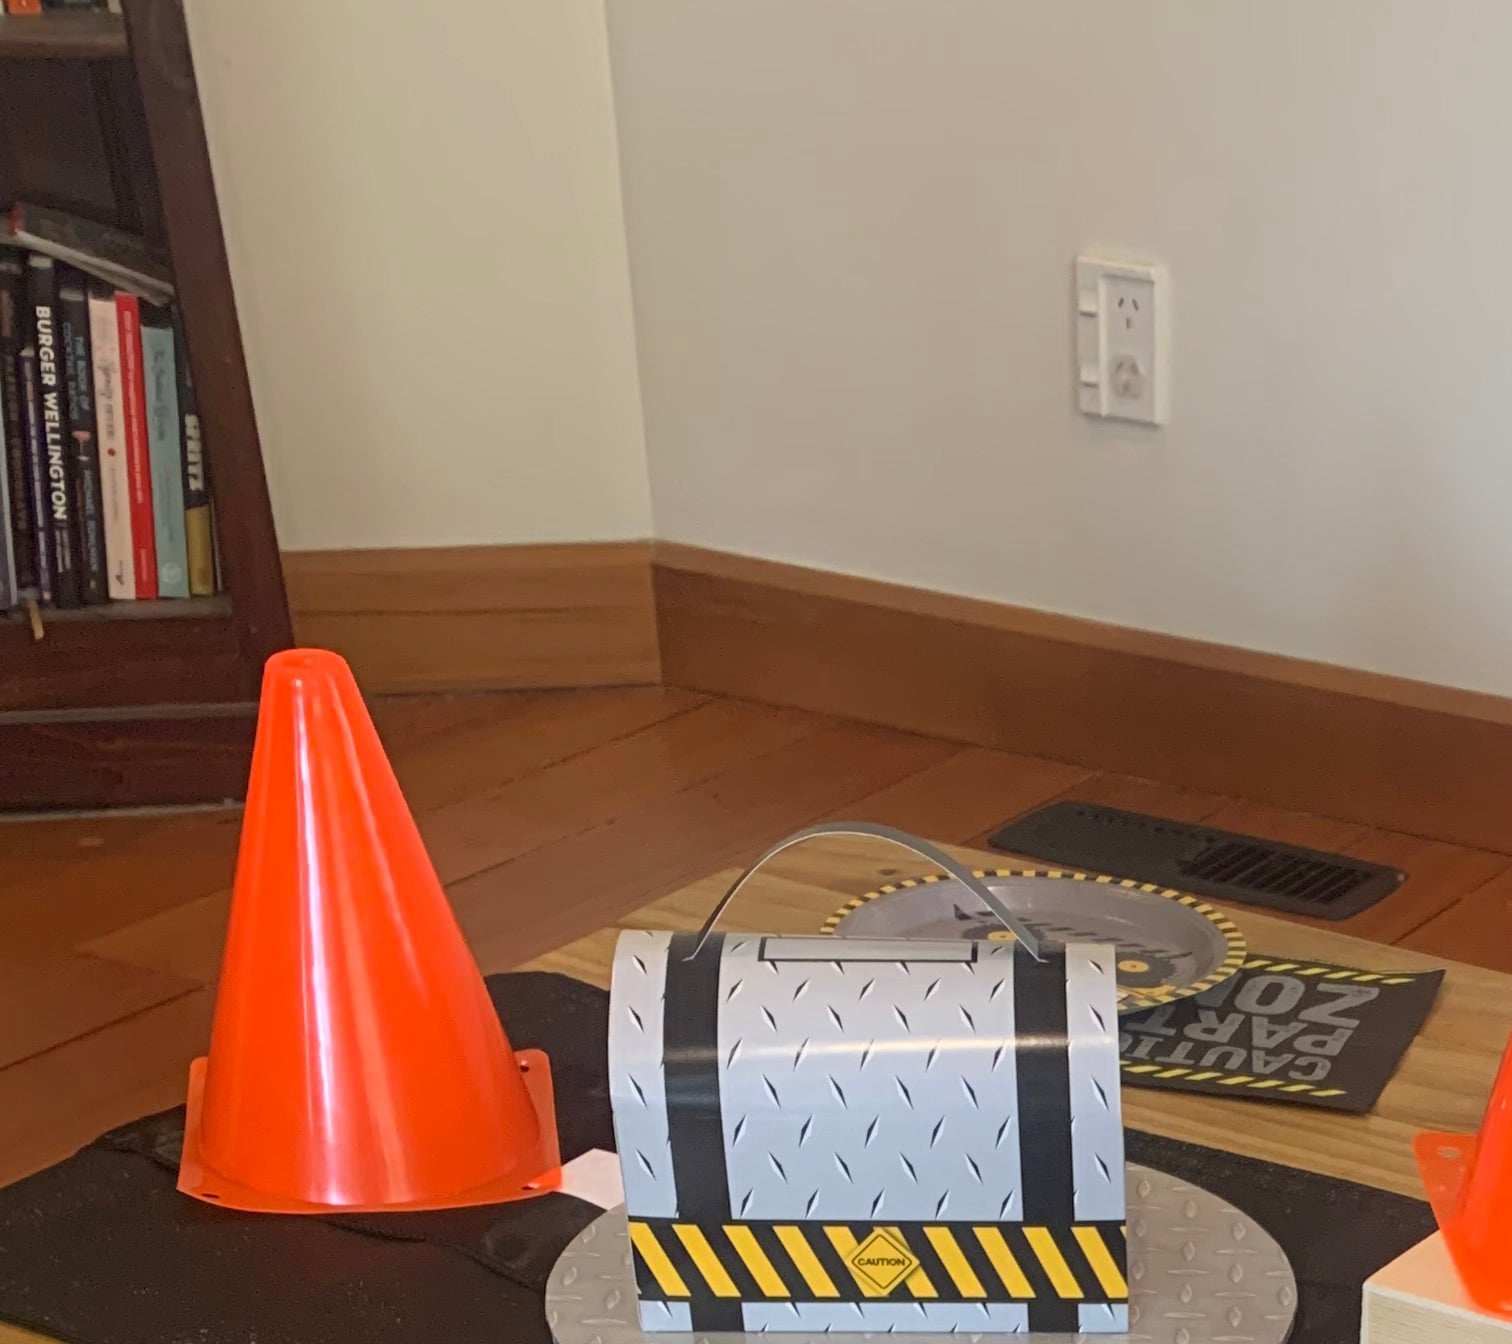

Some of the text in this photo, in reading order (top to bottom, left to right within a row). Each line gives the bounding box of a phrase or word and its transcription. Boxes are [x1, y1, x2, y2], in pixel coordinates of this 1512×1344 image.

[36, 305, 57, 387] BURGER
[43, 391, 68, 520] WELLINGTON
[1119, 1033, 1332, 1081] CAUTI
[1124, 1005, 1355, 1057] PART
[857, 1257, 906, 1267] CAUTION
